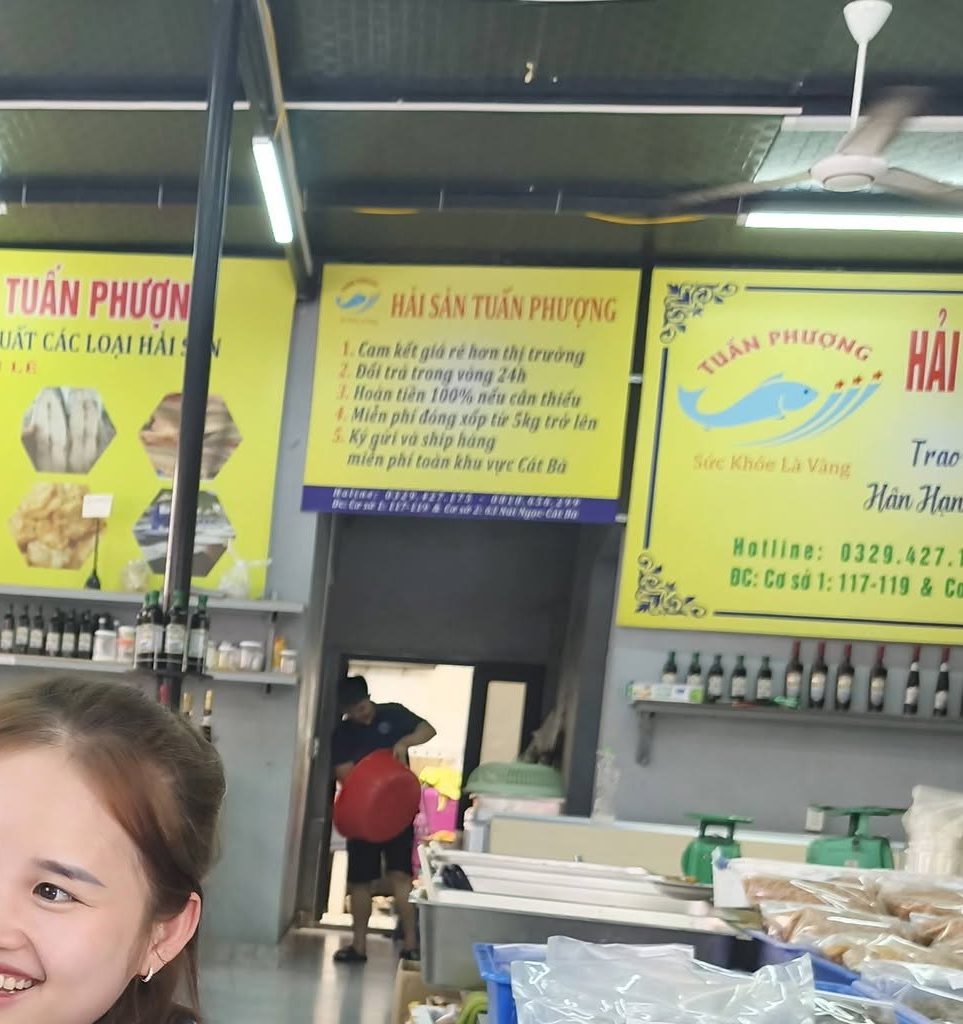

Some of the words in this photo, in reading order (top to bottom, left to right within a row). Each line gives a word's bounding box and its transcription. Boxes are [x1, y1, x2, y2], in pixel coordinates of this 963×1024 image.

[6, 264, 80, 317] TUẤN
[89, 277, 190, 330] PHƯỢN
[390, 286, 426, 320] HẢI
[429, 285, 467, 321] SẢN
[472, 285, 523, 321] TUẤN
[528, 293, 619, 329] PHƯỢNG
[42, 327, 82, 354] CÁC
[86, 332, 133, 362] LOẠI
[139, 331, 176, 357] HẢI
[357, 340, 390, 359] Cam
[393, 340, 418, 359] kết
[697, 334, 761, 376] TUẤN
[768, 328, 873, 362] PHƯỢNG
[905, 308, 961, 394] HẢI
[410, 366, 454, 387] trong
[497, 366, 527, 384] 24h
[431, 387, 474, 406] 100%
[511, 411, 541, 434] 5kg
[420, 431, 455, 453] ship
[911, 439, 961, 468] Trao
[453, 453, 483, 472] khu
[517, 454, 544, 475] Cát
[863, 481, 914, 514] Hân
[914, 483, 963, 518] Hạn
[733, 537, 824, 562] Hotline:
[764, 568, 786, 590] Cơ
[791, 568, 812, 592] sở
[818, 571, 832, 593] 1:
[839, 573, 910, 597] 117-119
[920, 576, 933, 598] &
